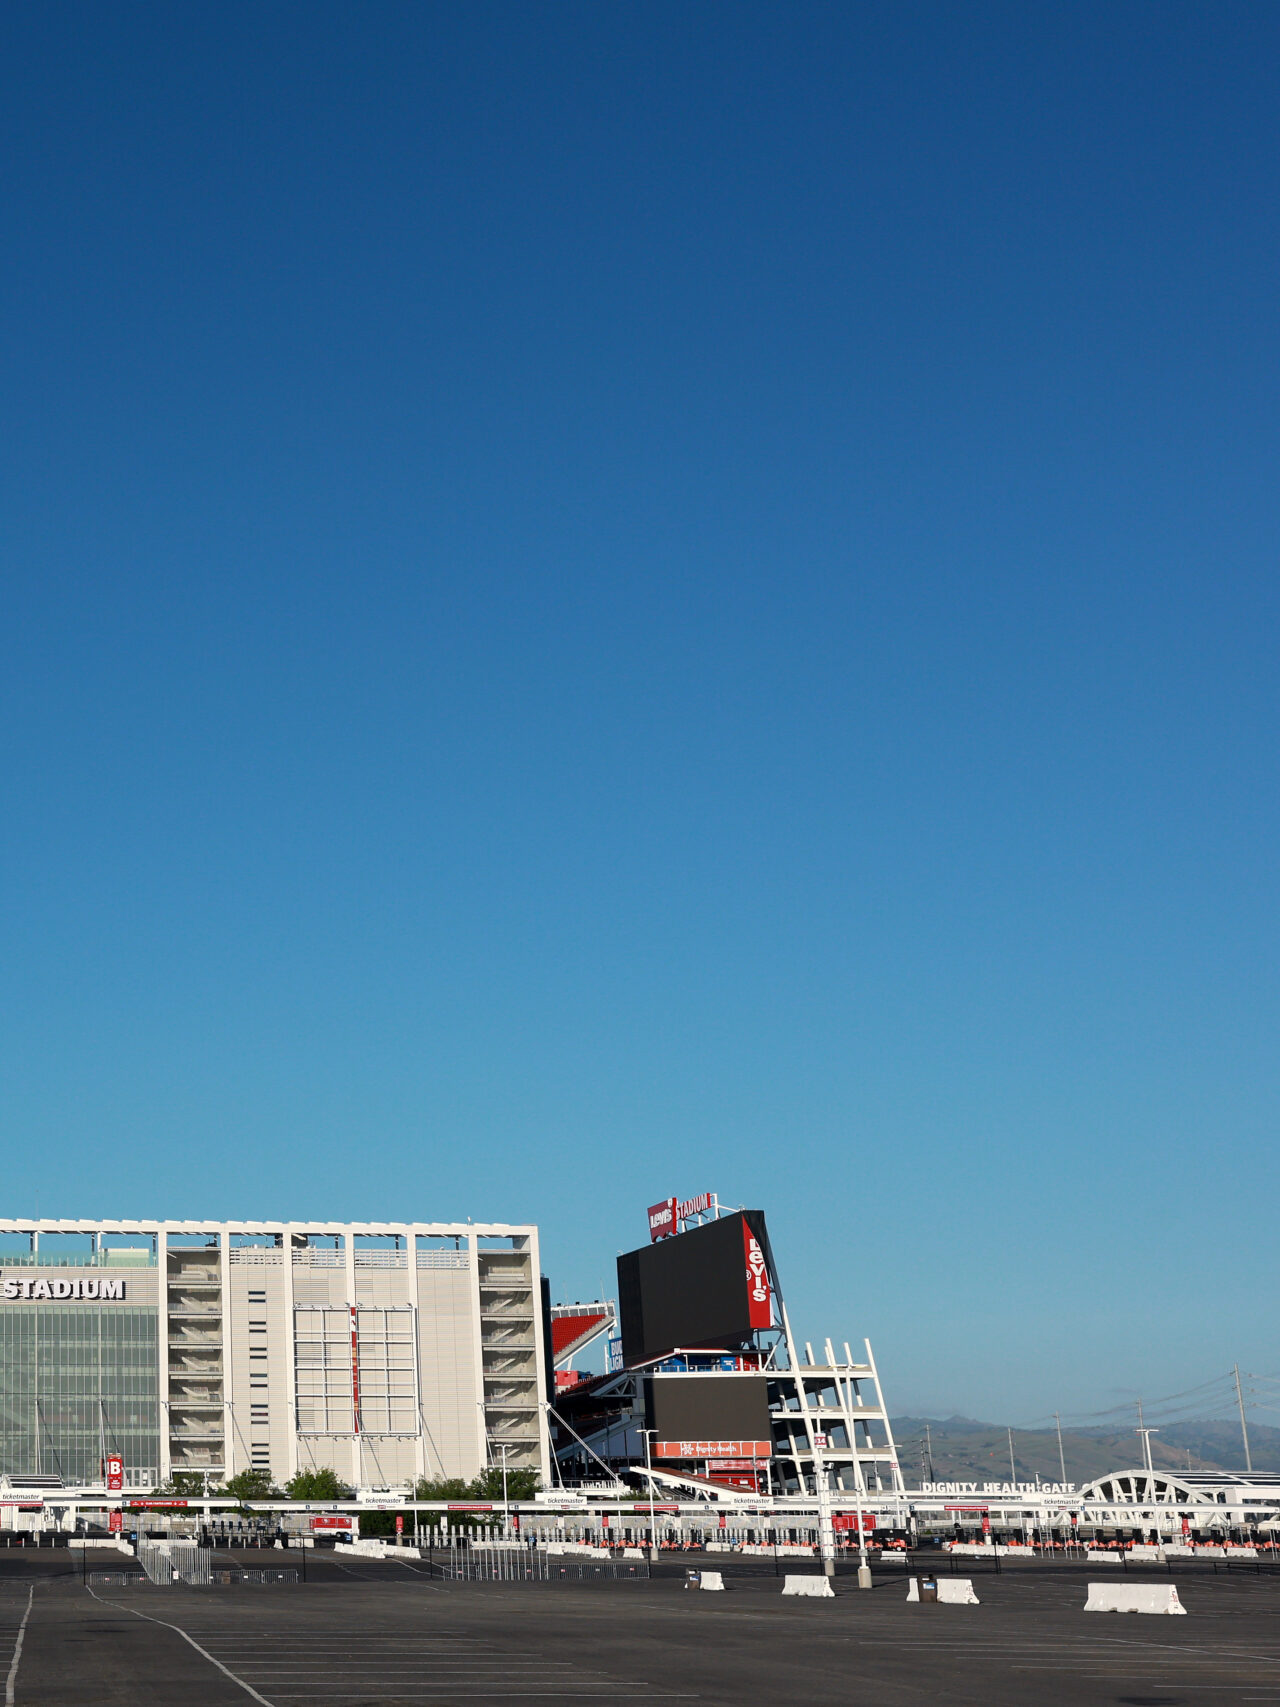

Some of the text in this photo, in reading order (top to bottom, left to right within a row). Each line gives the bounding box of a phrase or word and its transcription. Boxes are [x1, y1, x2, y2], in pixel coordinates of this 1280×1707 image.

[676, 1193, 708, 1220] STADIUM
[3, 1279, 124, 1299] STADIUM
[110, 1461, 121, 1475] B
[923, 1482, 977, 1493] DIGNITY
[984, 1482, 1037, 1493] HEALTH
[1042, 1483, 1076, 1494] GATE
